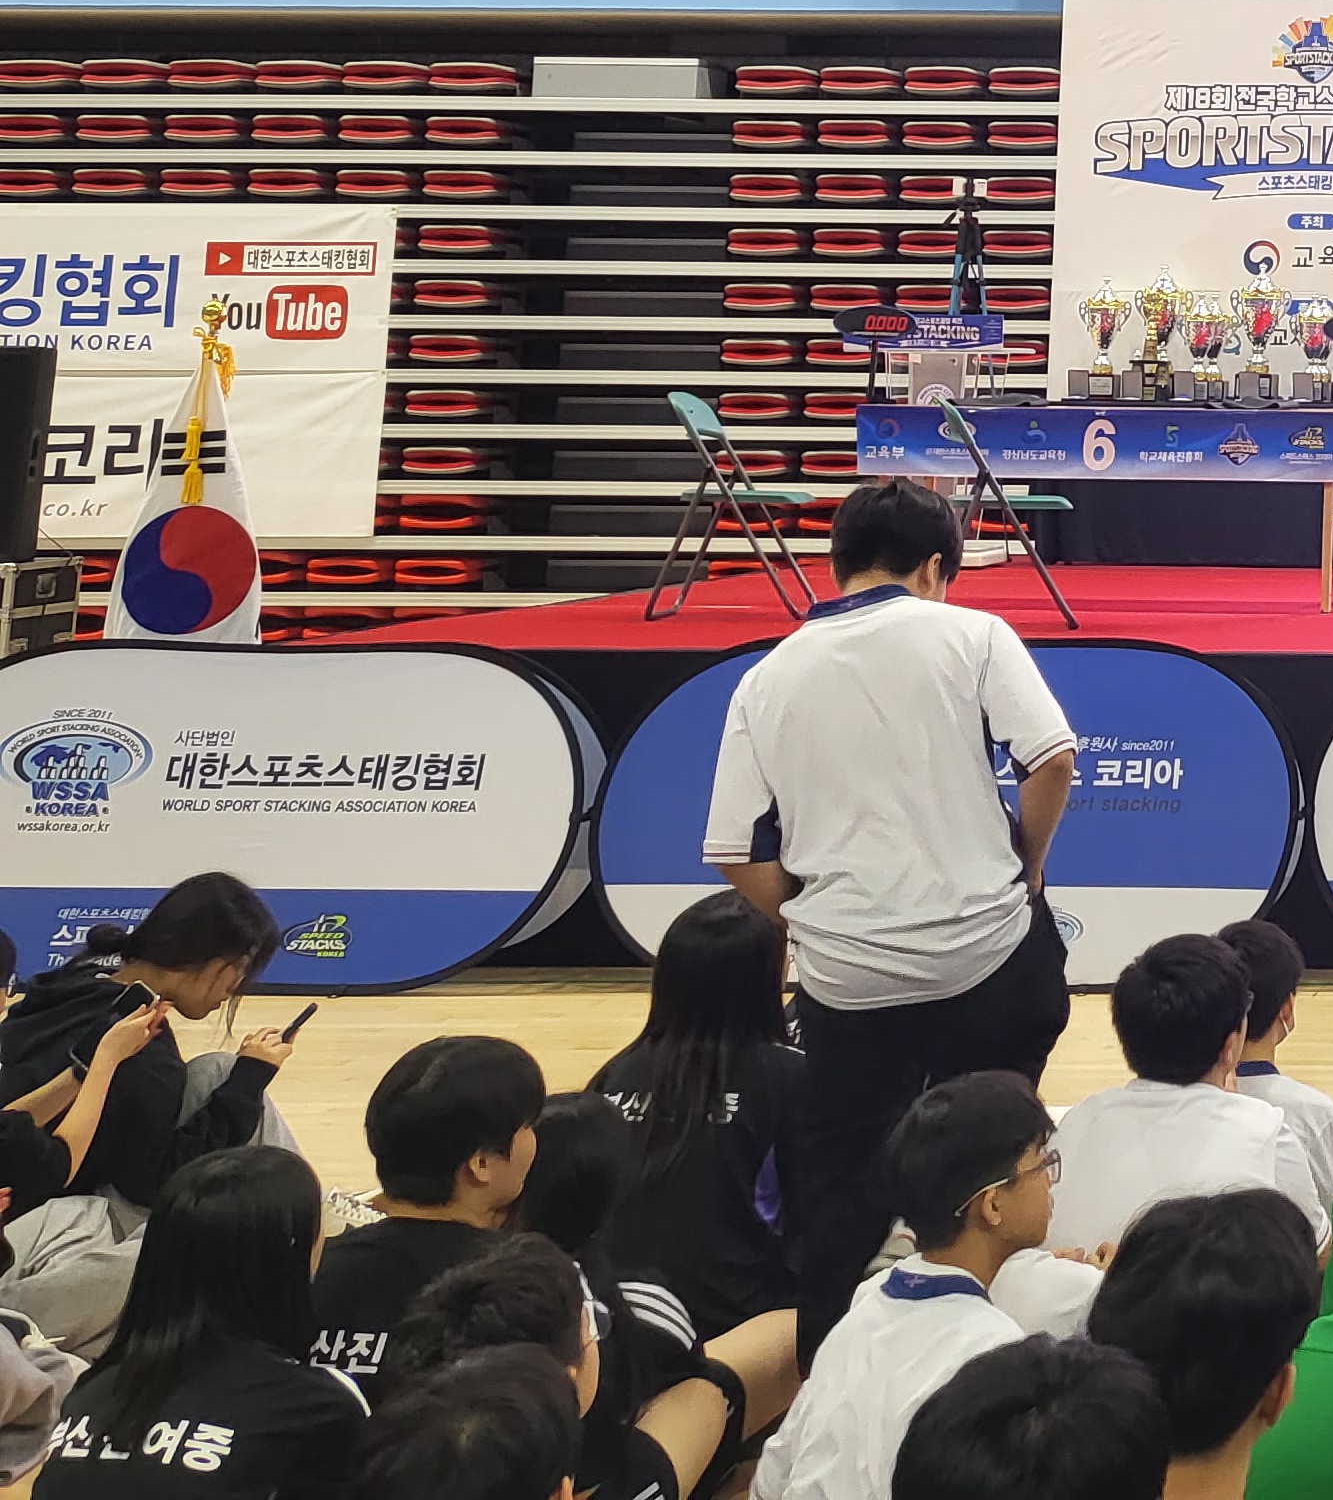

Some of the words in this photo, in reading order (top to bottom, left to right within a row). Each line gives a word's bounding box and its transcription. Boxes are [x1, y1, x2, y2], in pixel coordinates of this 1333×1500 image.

[1165, 84, 1232, 113] 제18회
[1257, 174, 1333, 192] 스포츠스태킹
[1300, 215, 1325, 229] 주최
[247, 247, 372, 272] 대한스포츠스태킹협회
[0, 253, 181, 328] 킹협회
[70, 334, 153, 351] KOREA
[864, 445, 905, 460] 교육부
[1082, 418, 1117, 471] 6
[52, 708, 86, 719] SINCE
[87, 709, 113, 719] 2011
[174, 729, 236, 747] 사단법인
[1121, 739, 1175, 752] since2011
[164, 751, 487, 792] 대한스포츠스태킹협회
[1093, 757, 1184, 790] 코리아
[31, 781, 110, 802] WSSA
[34, 802, 100, 817] KOREA
[161, 799, 211, 813] WORLD
[214, 799, 262, 813] SPORT
[263, 799, 332, 813] STACKING
[334, 799, 428, 814] ASSOCIATION
[430, 800, 478, 814] KOREA
[1101, 796, 1182, 815] stacking
[17, 820, 111, 833] wssakorea.or.kr
[286, 939, 347, 951] STACKS
